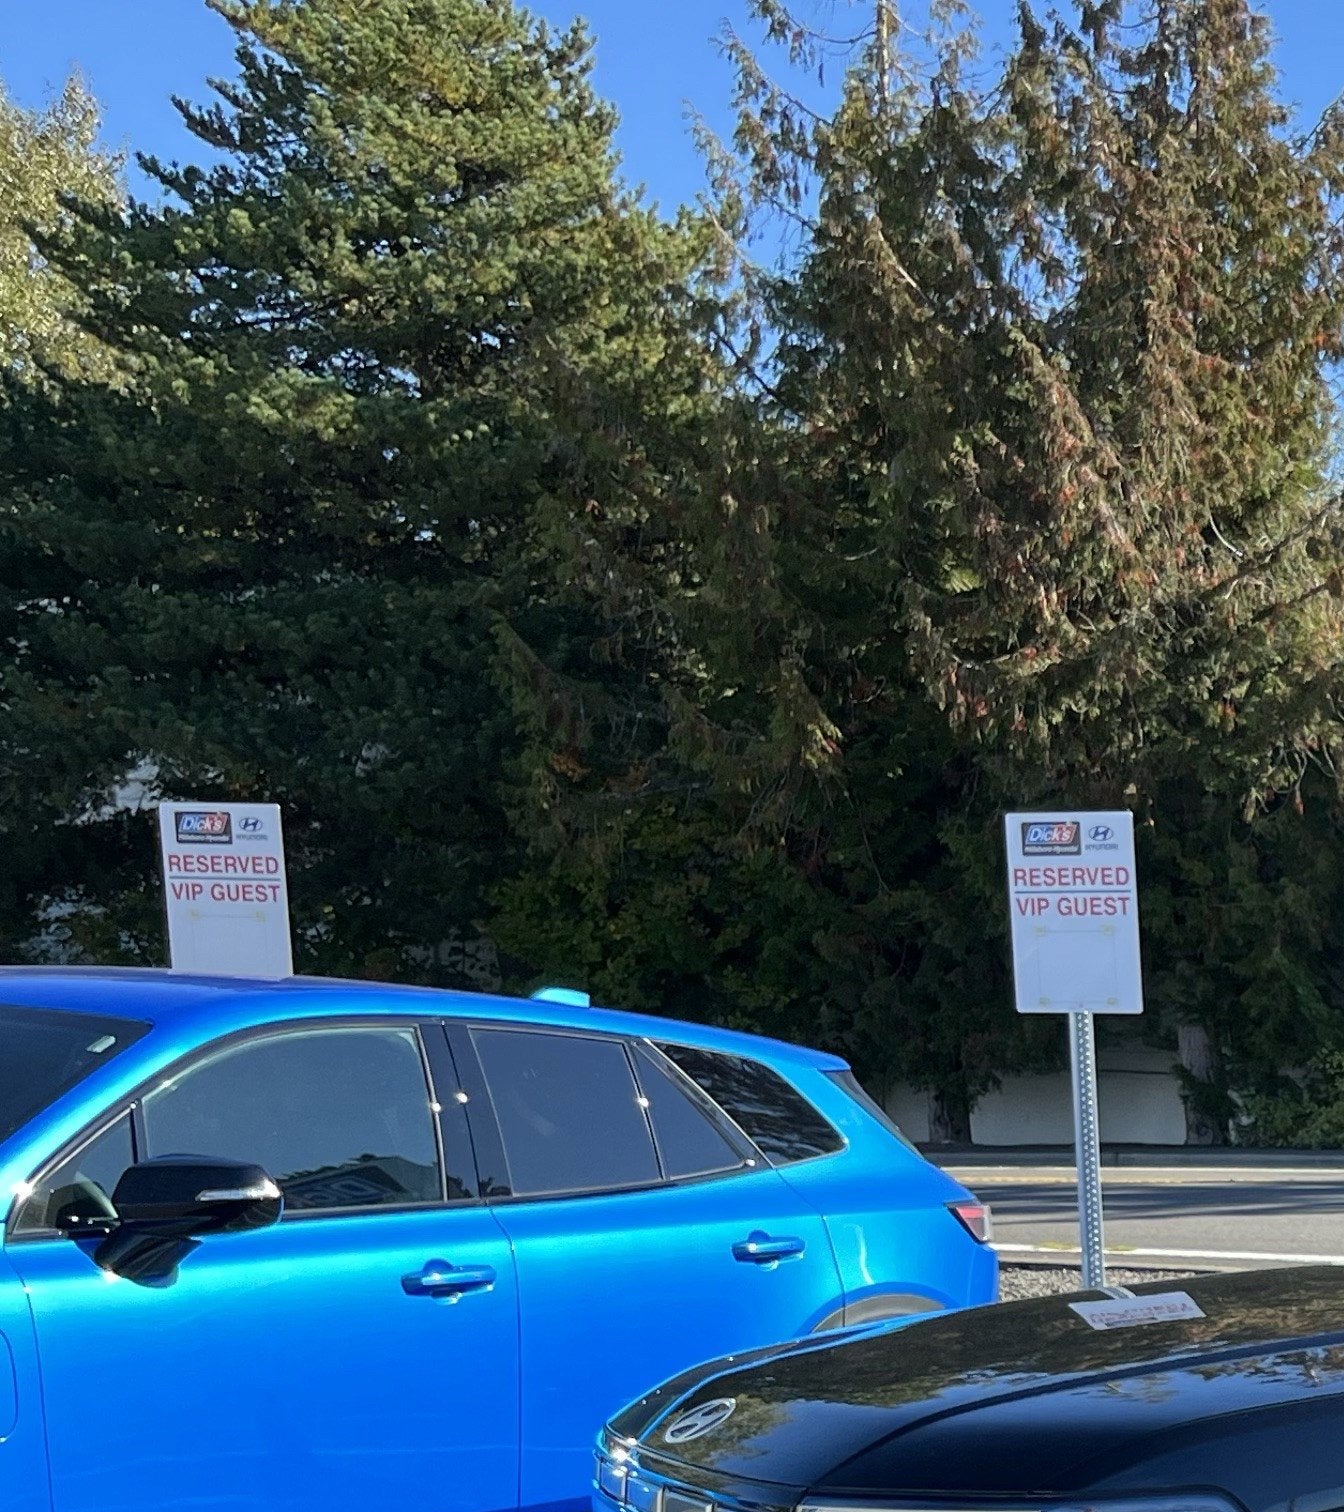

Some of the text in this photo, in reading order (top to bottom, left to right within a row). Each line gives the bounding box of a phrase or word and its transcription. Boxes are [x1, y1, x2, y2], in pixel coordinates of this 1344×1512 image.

[168, 854, 279, 875] RESERVED
[1013, 867, 1130, 887] RESERVED
[171, 883, 280, 903] VIP GUEST
[1016, 897, 1130, 916] VIP GUEST
